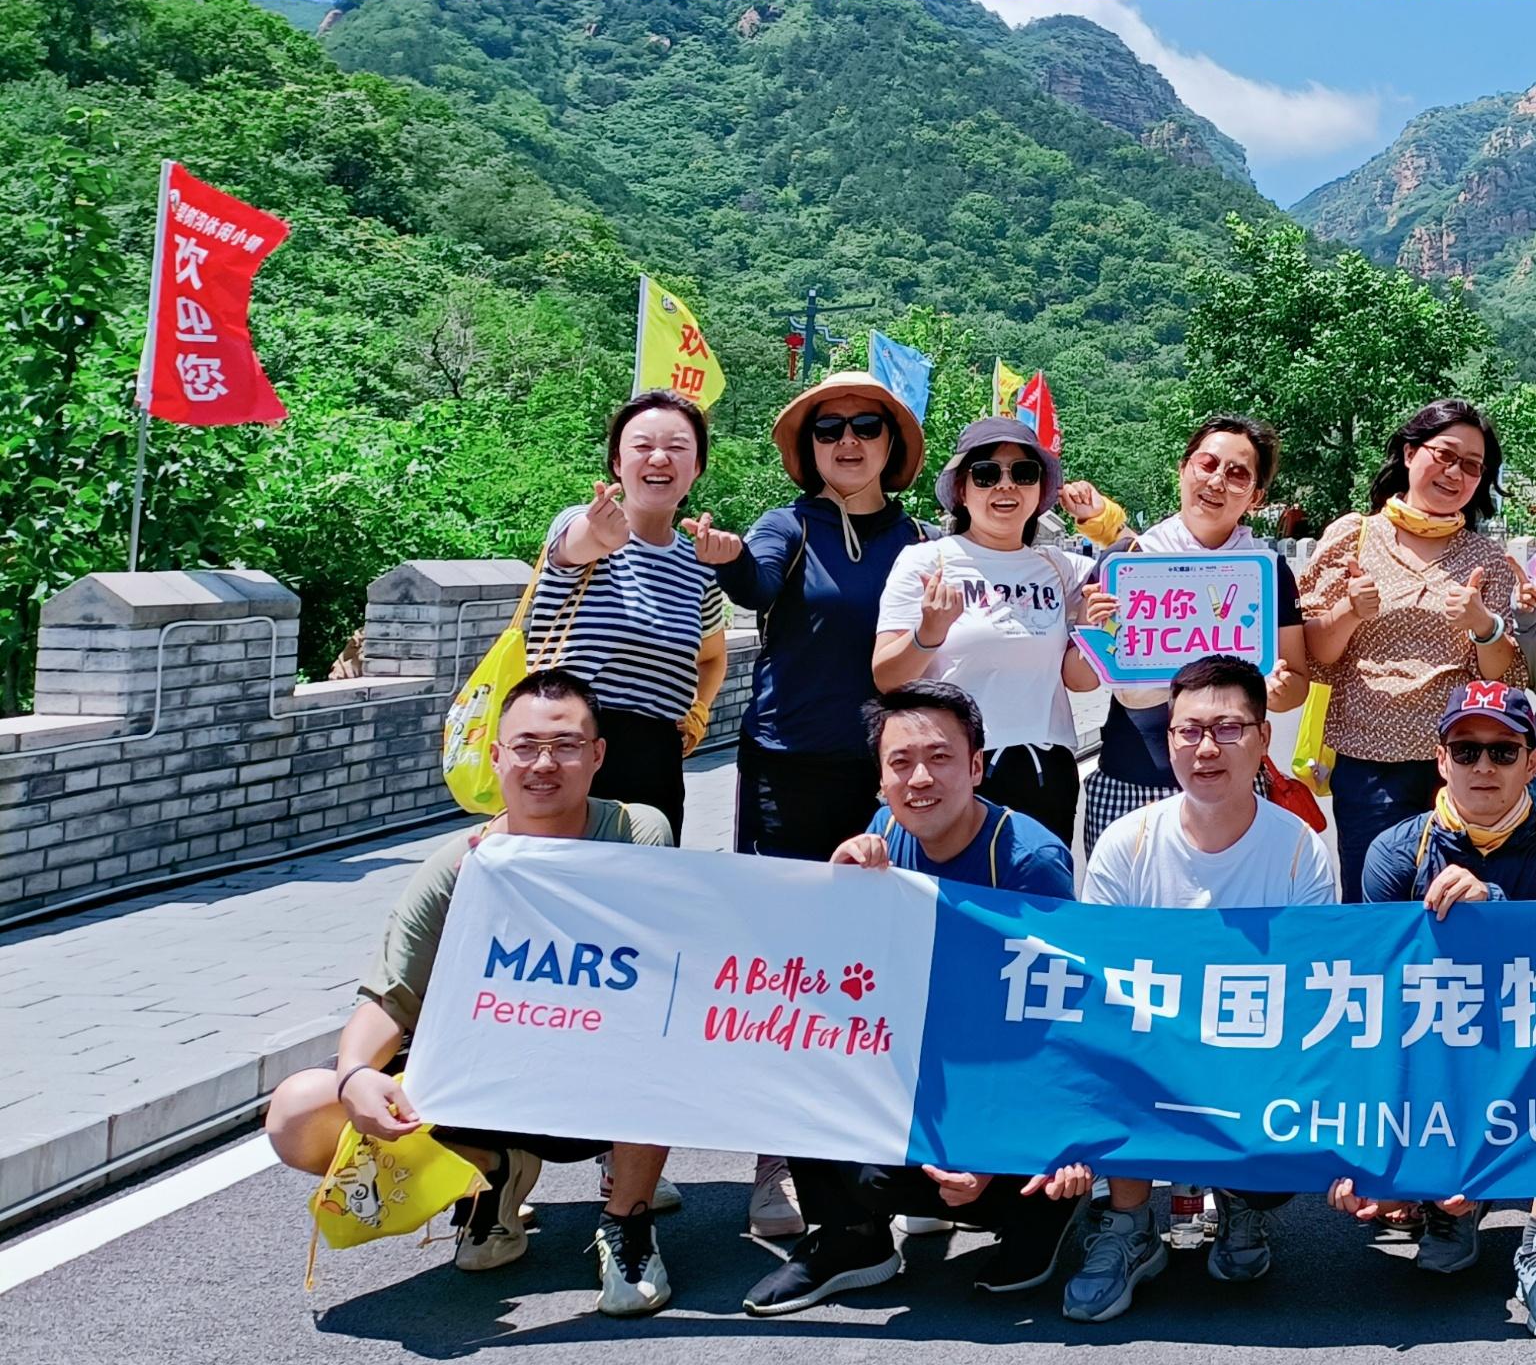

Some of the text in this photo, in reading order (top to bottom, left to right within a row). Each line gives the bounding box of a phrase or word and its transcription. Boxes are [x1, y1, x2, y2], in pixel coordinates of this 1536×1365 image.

[671, 323, 710, 401] 欢迎
[1126, 589, 1197, 621] 为你
[1123, 624, 1256, 657] 打CALL
[1462, 680, 1509, 712] M
[483, 935, 640, 992] MARS
[713, 954, 831, 1004] A Better
[471, 990, 602, 1033] Petcare
[703, 1005, 894, 1056] World For Pets
[1262, 1096, 1457, 1149] CHINA
